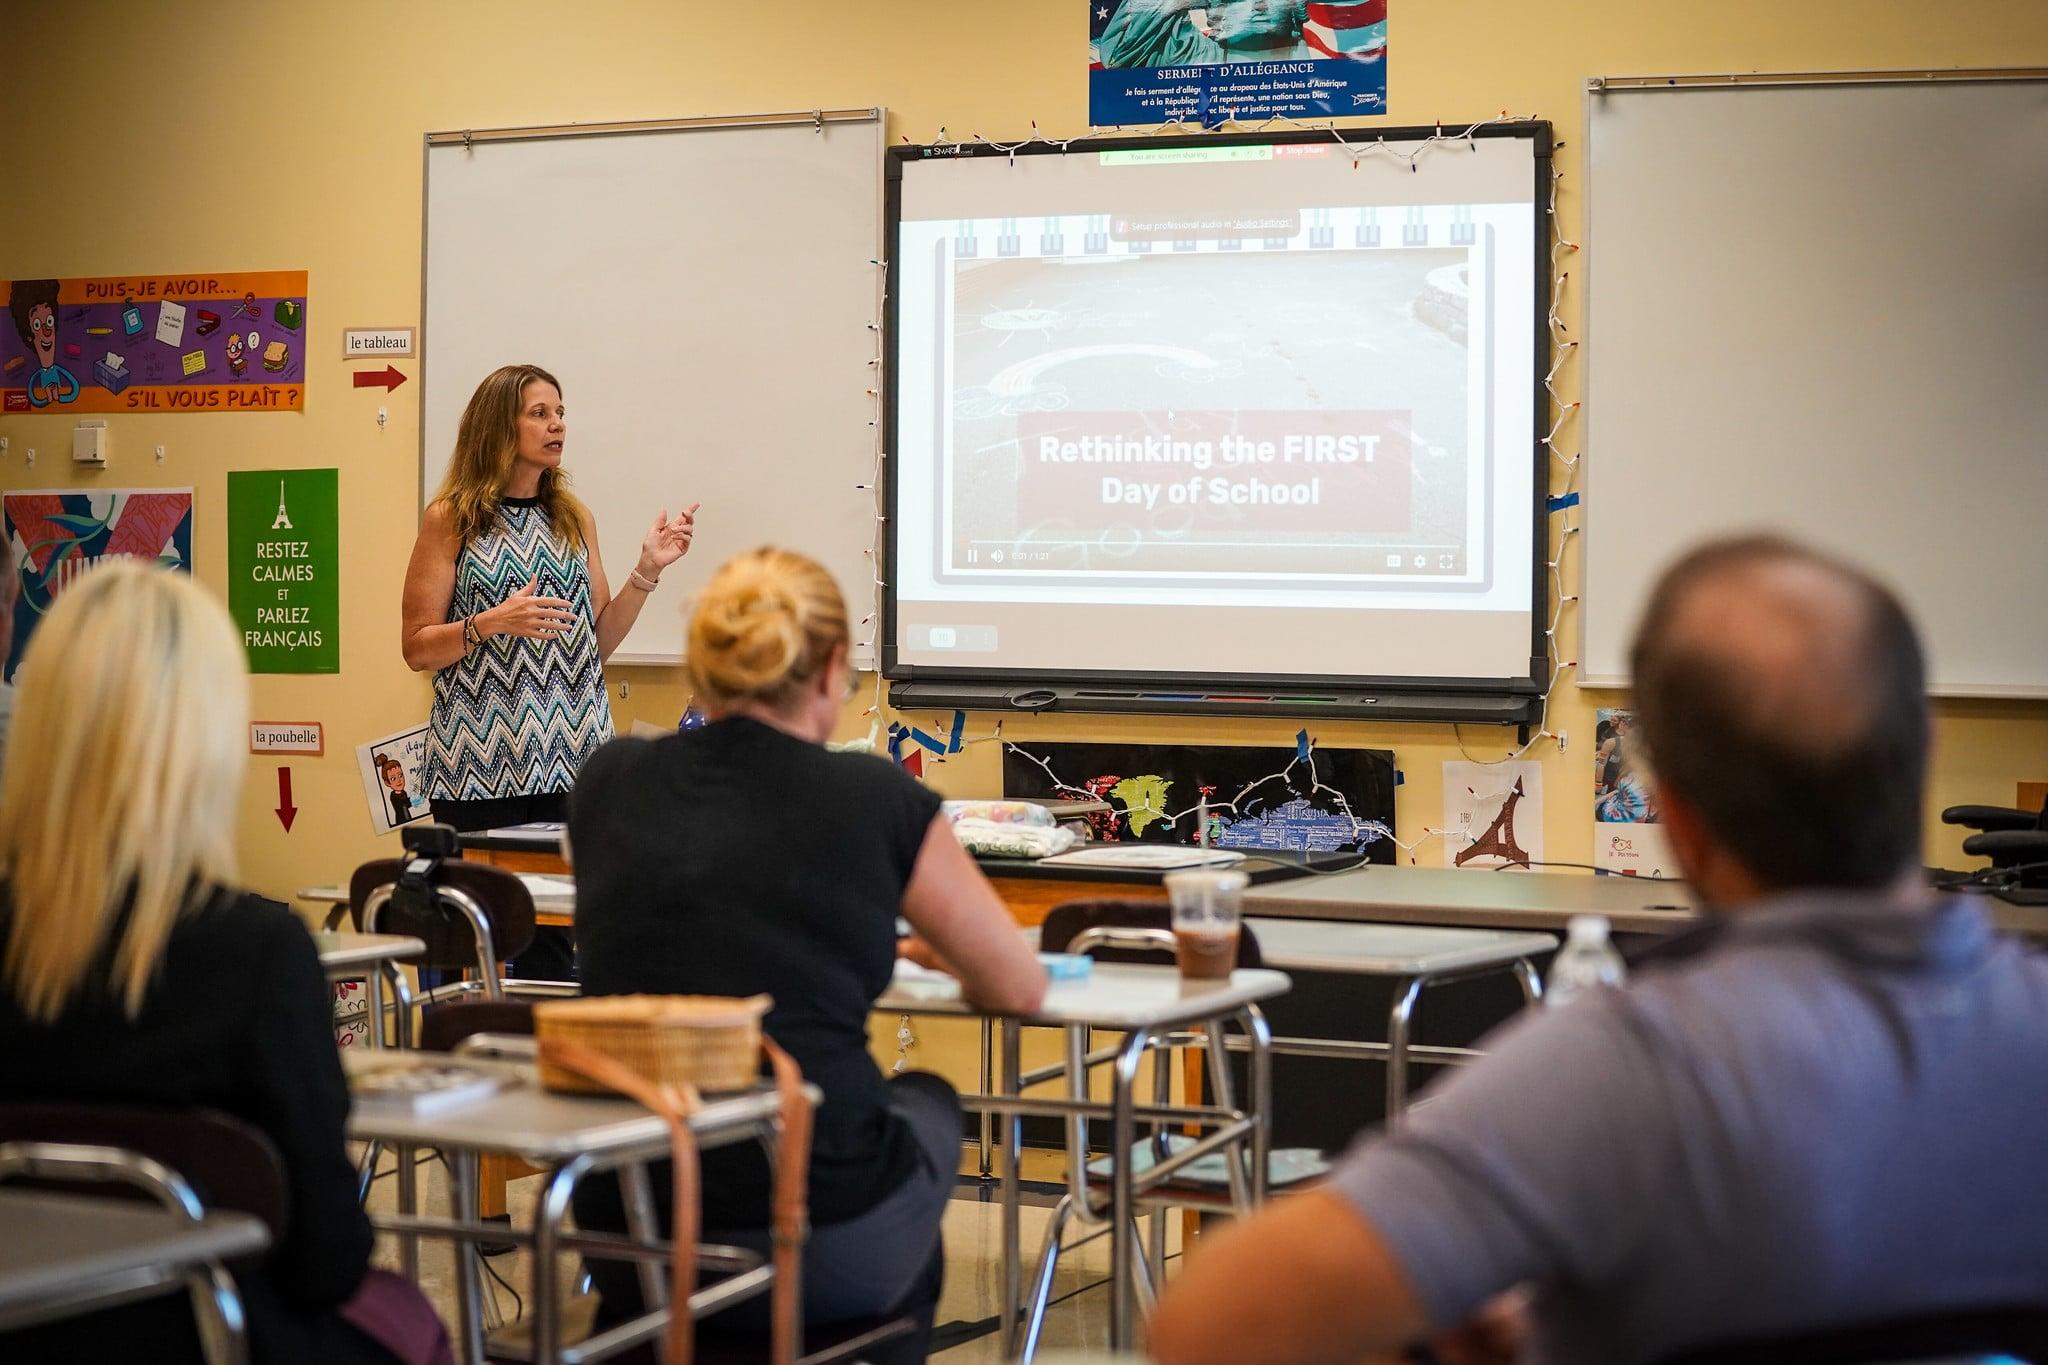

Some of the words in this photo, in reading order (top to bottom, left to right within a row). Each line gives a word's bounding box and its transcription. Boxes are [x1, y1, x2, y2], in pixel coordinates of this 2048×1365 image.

[1220, 61, 1315, 77] D'ALLÉGEANCE
[1134, 87, 1146, 96] fais
[1148, 87, 1174, 95] serment
[1229, 83, 1258, 93] drapeau
[1259, 82, 1271, 91] des
[1273, 80, 1306, 90] États-Unis
[1307, 79, 1347, 90] d'Amérique
[1156, 97, 1163, 105] la
[1219, 94, 1256, 105] représente,
[1258, 94, 1270, 102] une
[1272, 92, 1294, 101] nation
[1312, 90, 1330, 100] Dieu,
[1249, 104, 1271, 115] justice
[1272, 105, 1288, 114] pour
[1289, 103, 1306, 111] tous.
[1182, 150, 1208, 161] sharing
[86, 281, 157, 298] PUIS-JE
[163, 279, 237, 296] AVOIR...
[350, 334, 361, 349] le
[363, 333, 407, 350] tableau
[126, 390, 160, 408] S'IL
[168, 390, 220, 407] VOUS
[226, 385, 282, 407] PLAÎT
[1039, 434, 1212, 470] Rethinking
[1219, 434, 1275, 463] the
[1283, 434, 1381, 463] FIRST
[1101, 476, 1160, 510] Day
[1168, 475, 1202, 504] of
[1208, 476, 1320, 505] School
[257, 541, 309, 559] RESTEZ
[252, 565, 314, 581] CALMES
[277, 589, 289, 600] ET
[257, 607, 310, 624] PARLEZ
[245, 630, 322, 651] FRANÇAIS
[256, 729, 266, 743] la
[268, 729, 317, 746] poubelle
